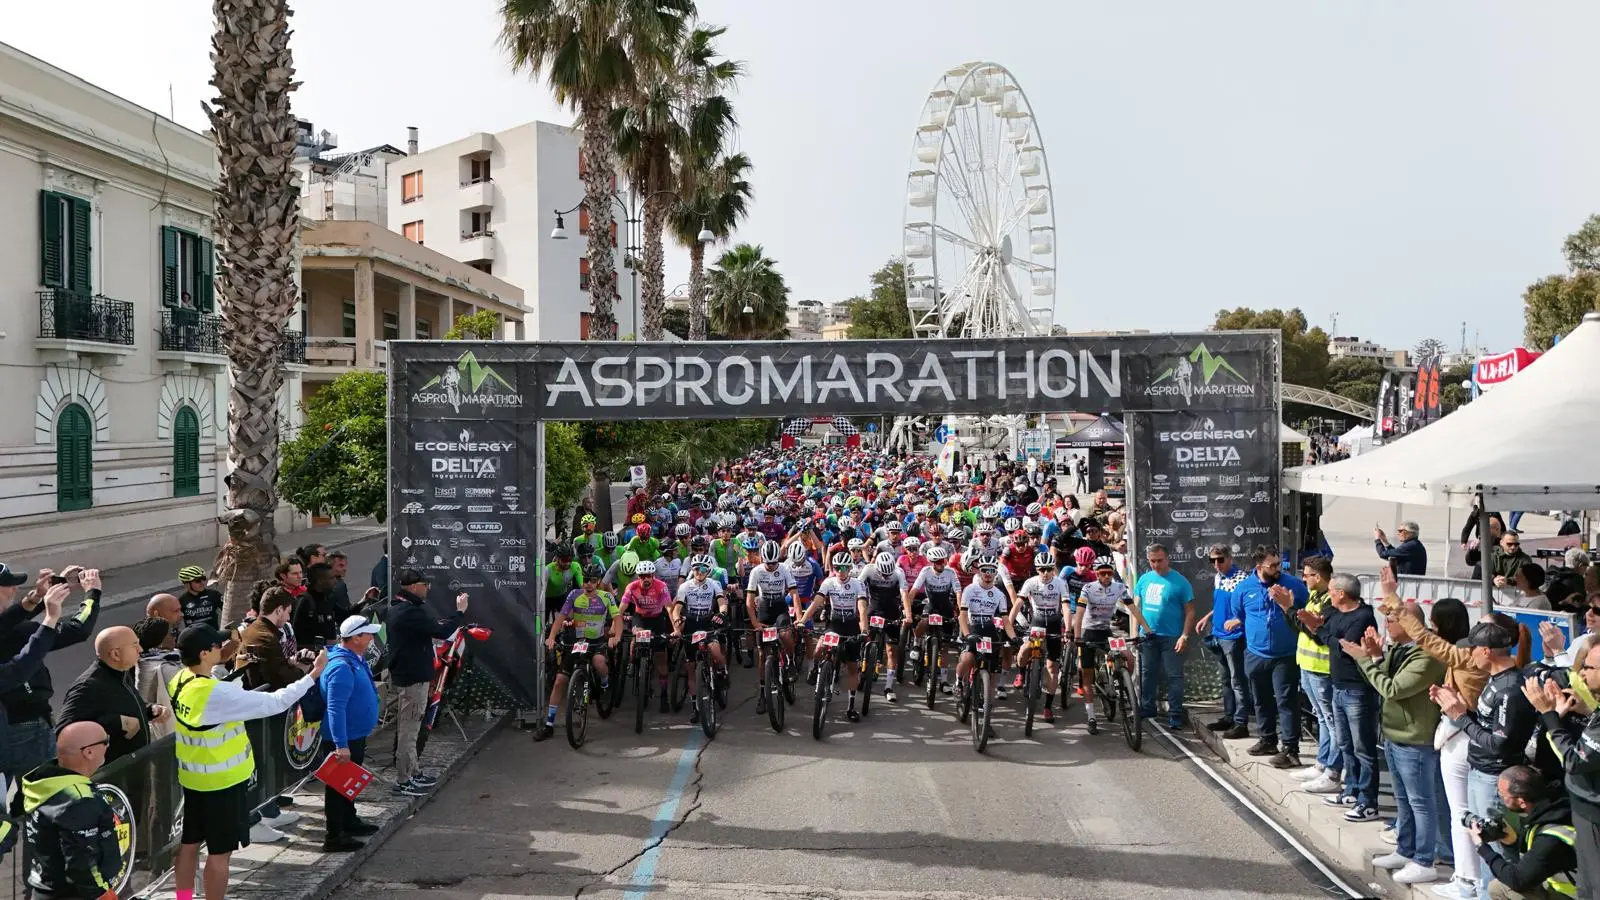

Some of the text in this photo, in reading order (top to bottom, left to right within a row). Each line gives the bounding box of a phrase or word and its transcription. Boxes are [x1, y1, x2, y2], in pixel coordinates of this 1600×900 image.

[545, 347, 1121, 407] ASPROMARATHON
[1144, 385, 1255, 396] ASPRO MARATHON
[412, 393, 523, 405] ASPRO MARATHON
[1160, 429, 1257, 442] ECOENERGY
[415, 442, 513, 452] ECOENERGY
[1176, 446, 1241, 466] DELTA
[432, 458, 496, 478] DELTA
[453, 556, 478, 569] CALA
[508, 556, 526, 565] PRO
